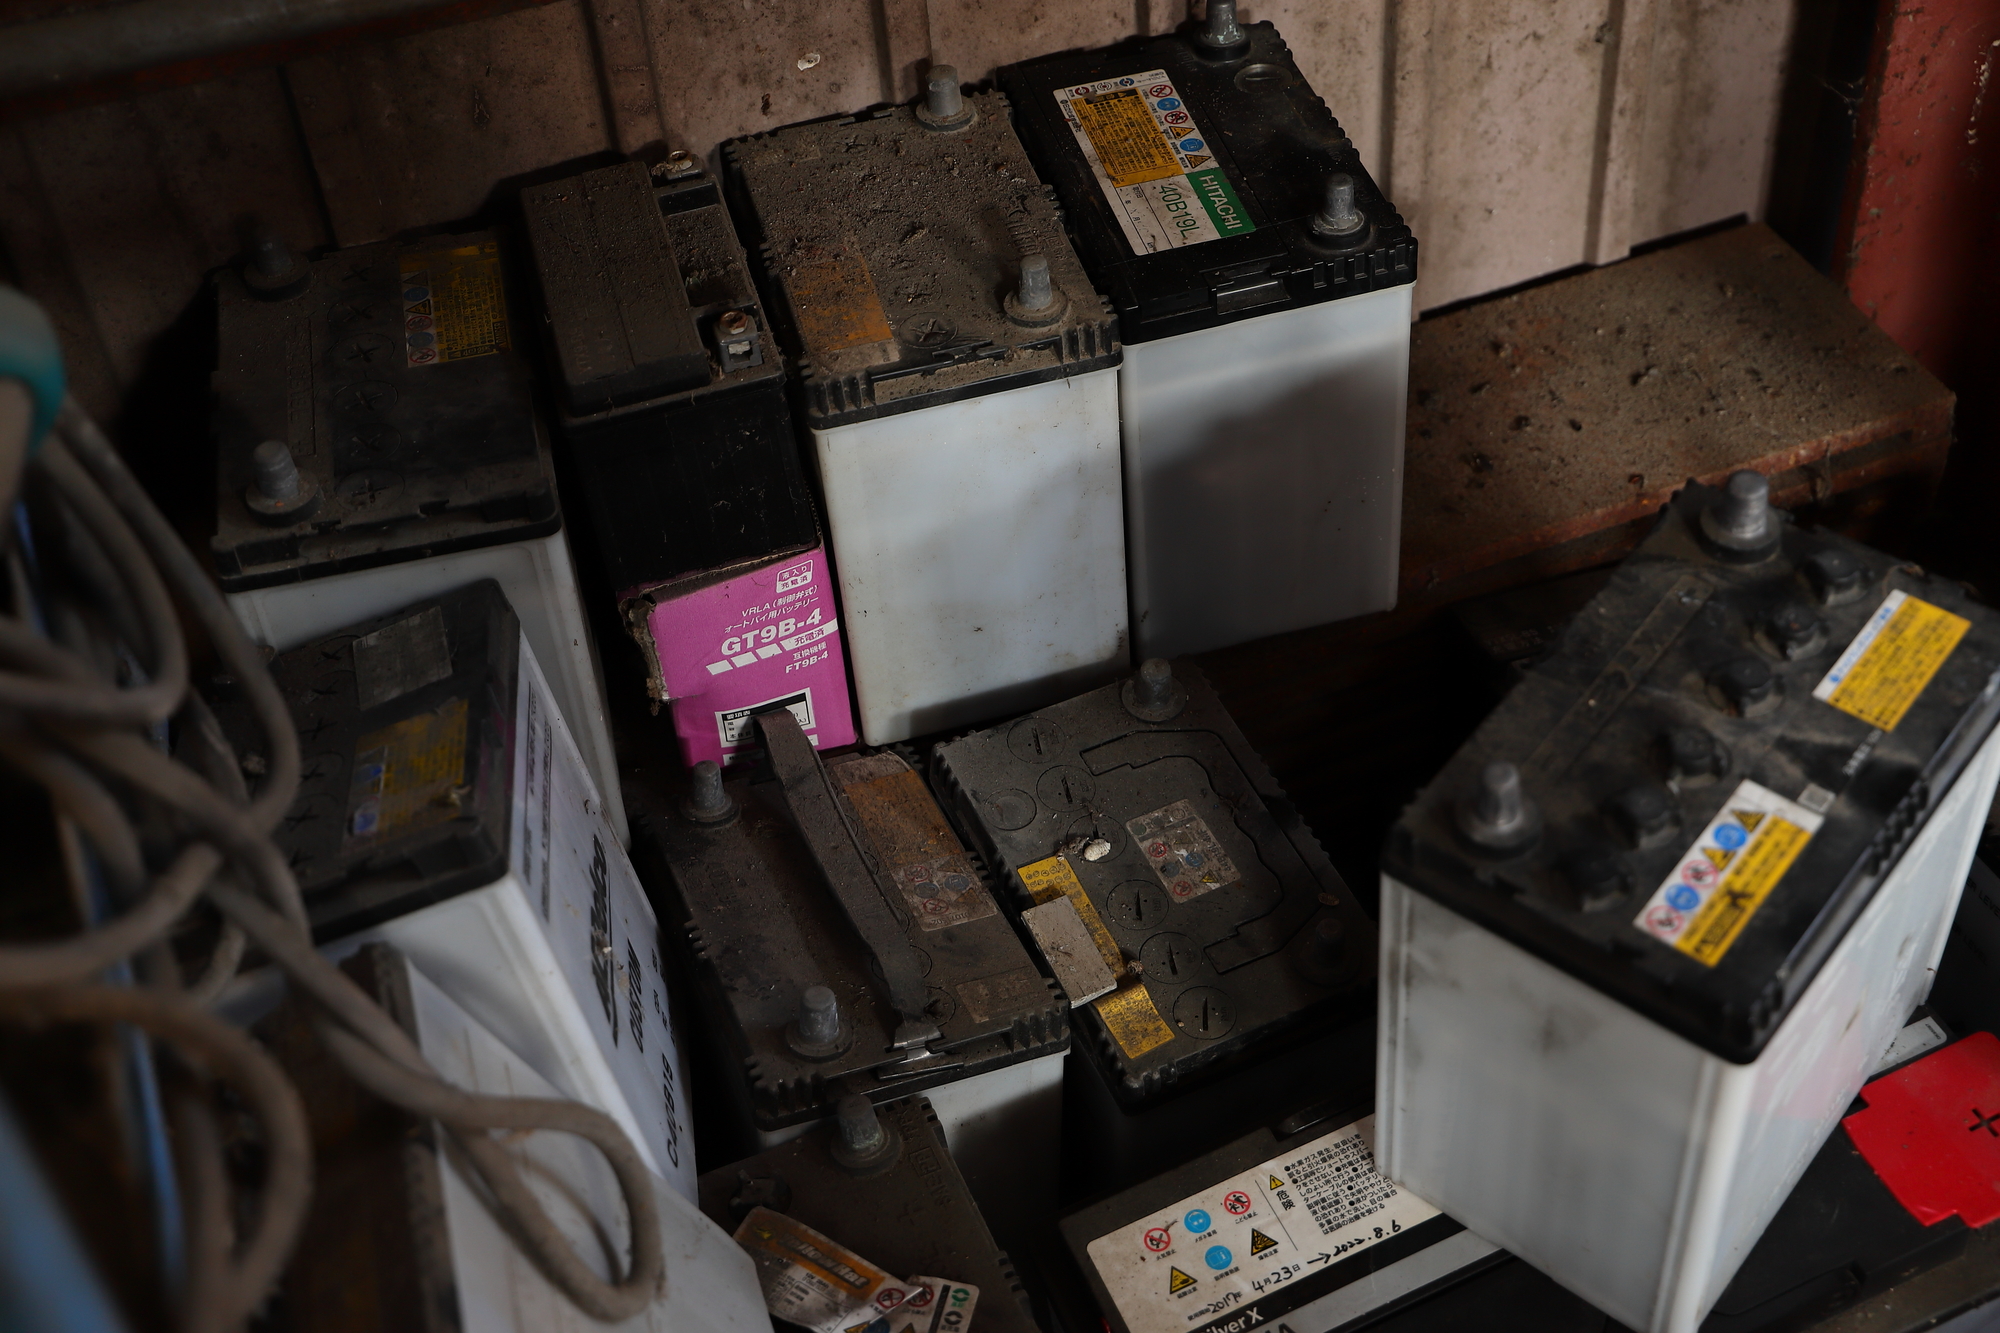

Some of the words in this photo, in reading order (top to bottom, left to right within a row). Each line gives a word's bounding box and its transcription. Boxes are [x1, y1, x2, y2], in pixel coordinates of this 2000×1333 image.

[1159, 184, 1201, 239] 40B19L
[1199, 174, 1244, 231] HITACHI
[780, 575, 808, 590] 充電済
[782, 564, 808, 580] 液入り
[724, 597, 819, 634] オートバイ用バッテリー
[721, 606, 822, 656] GT9B-4
[794, 627, 825, 647] 充電済
[785, 650, 828, 674] FT9B-4
[793, 640, 827, 661] 互換機種
[1978, 888, 2000, 919] LEVE
[627, 936, 645, 1054] CUSTOM
[661, 1053, 679, 1169] C40B19
[1294, 1168, 1334, 1191] クをさせない
[1298, 1169, 1351, 1197] しのよい所で行う
[1305, 1187, 1346, 1210] 説明書に従う
[1351, 1172, 1379, 1189] バッテリ
[1276, 1188, 1296, 1212] 危険
[1313, 1202, 1347, 1223] の恐れあり
[1353, 1181, 1394, 1205] 液がついたら
[1245, 1306, 1264, 1325] X
